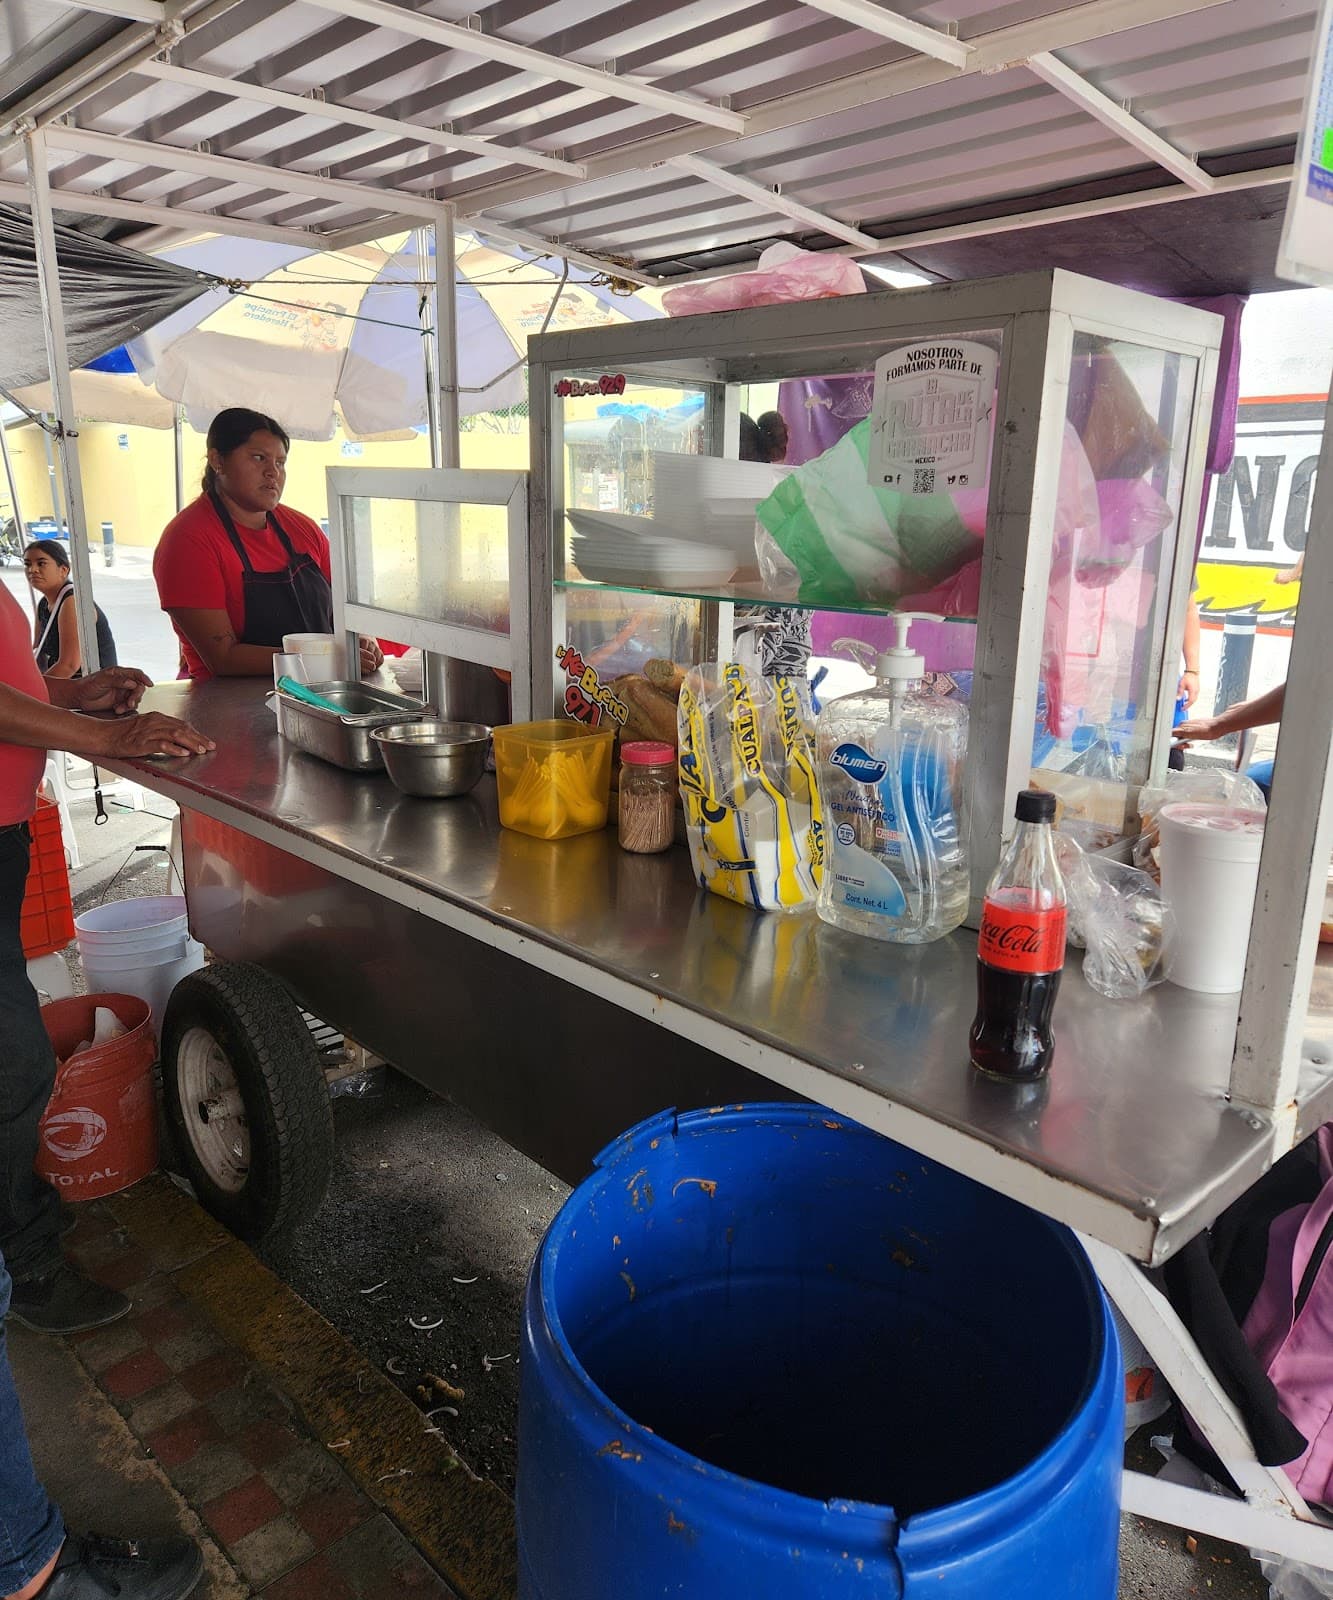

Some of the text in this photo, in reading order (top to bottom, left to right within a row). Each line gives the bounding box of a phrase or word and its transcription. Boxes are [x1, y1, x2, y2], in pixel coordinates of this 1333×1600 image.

[906, 347, 964, 362] NOSOTROS
[886, 358, 984, 382] FORMAMOS PARTE DE
[831, 752, 887, 773] blumen
[831, 802, 846, 813] GEL
[877, 900, 883, 910] 4
[883, 900, 889, 911] L
